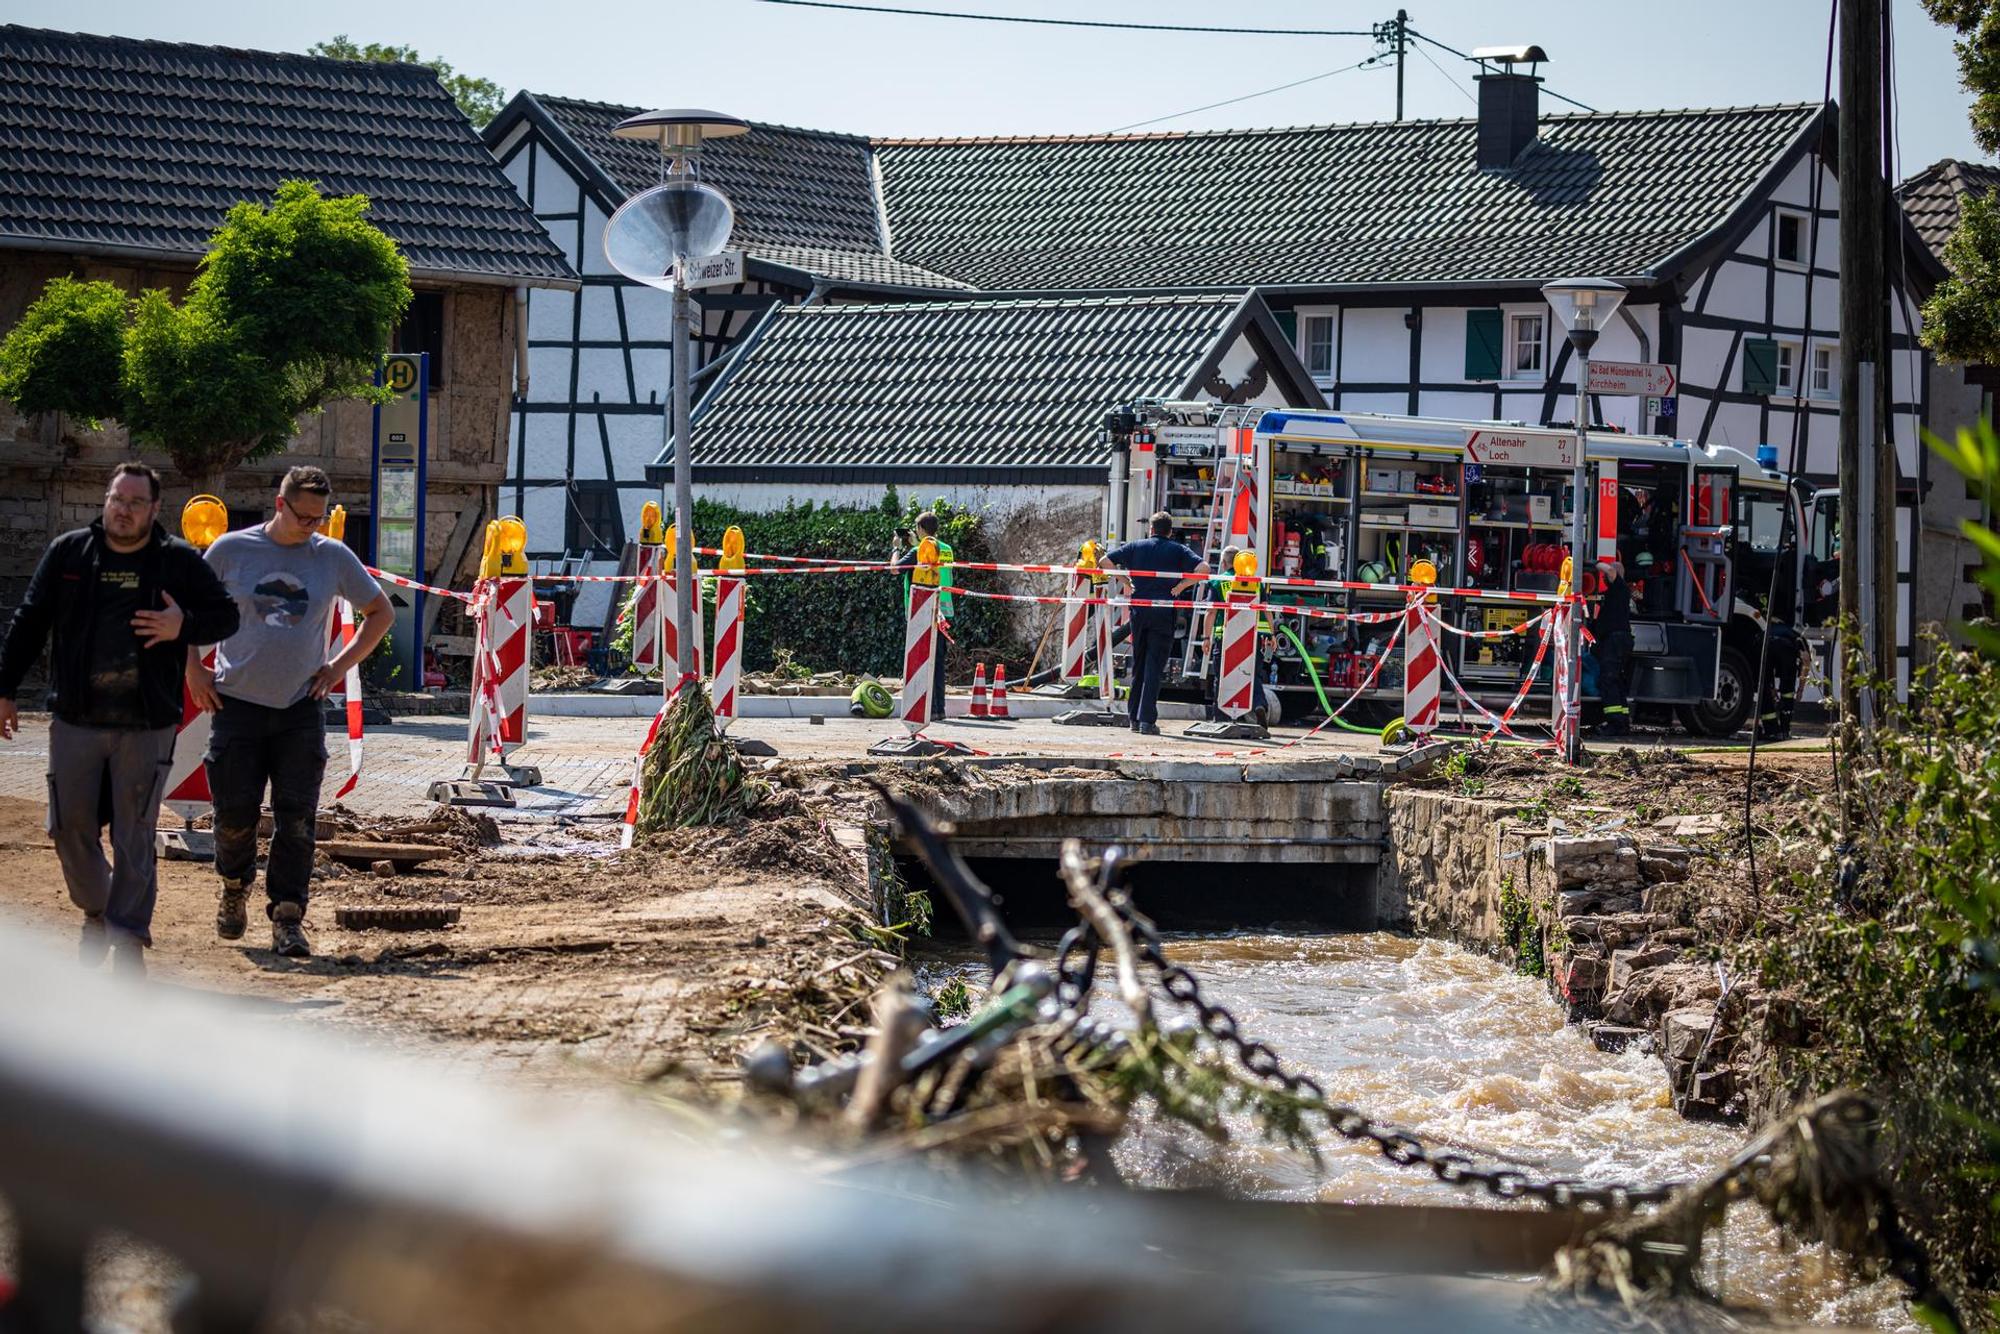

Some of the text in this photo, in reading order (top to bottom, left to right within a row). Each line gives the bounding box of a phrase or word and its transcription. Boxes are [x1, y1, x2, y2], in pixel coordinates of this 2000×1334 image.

[689, 257, 737, 281] Schweizer Str.
[392, 364, 408, 384] H
[1599, 363, 1653, 378] Bad Münstereifel 14
[1590, 379, 1626, 391] Kirchheim
[1490, 436, 1567, 450] Altenahr 27
[1489, 450, 1509, 461] Loch
[1600, 481, 1617, 497] 18
